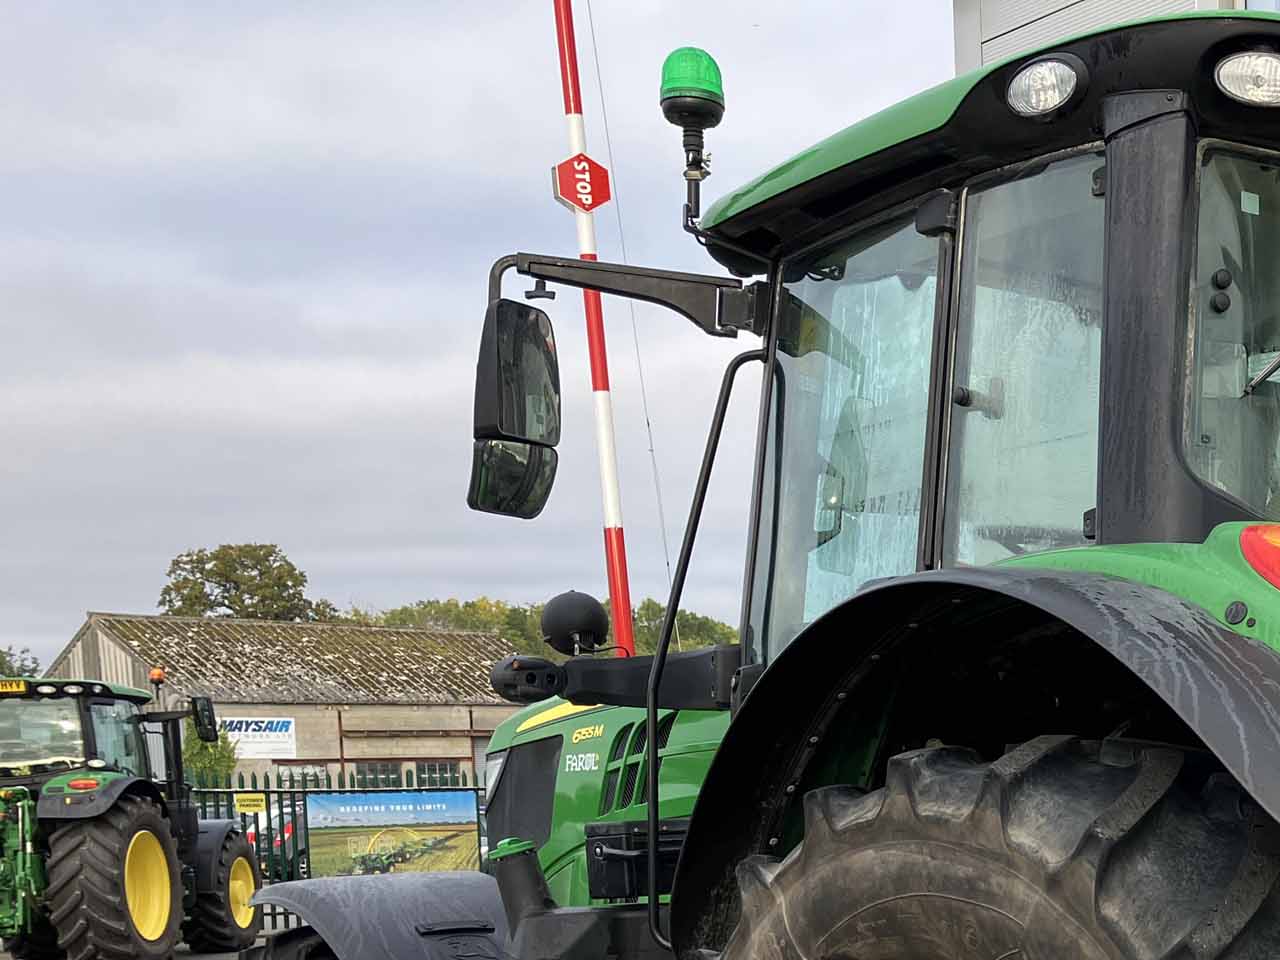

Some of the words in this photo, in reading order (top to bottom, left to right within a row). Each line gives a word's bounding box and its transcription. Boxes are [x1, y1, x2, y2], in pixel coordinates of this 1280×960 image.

[573, 160, 593, 205] STOP
[219, 719, 292, 733] MAYSAIR
[565, 752, 599, 772] FAROL
